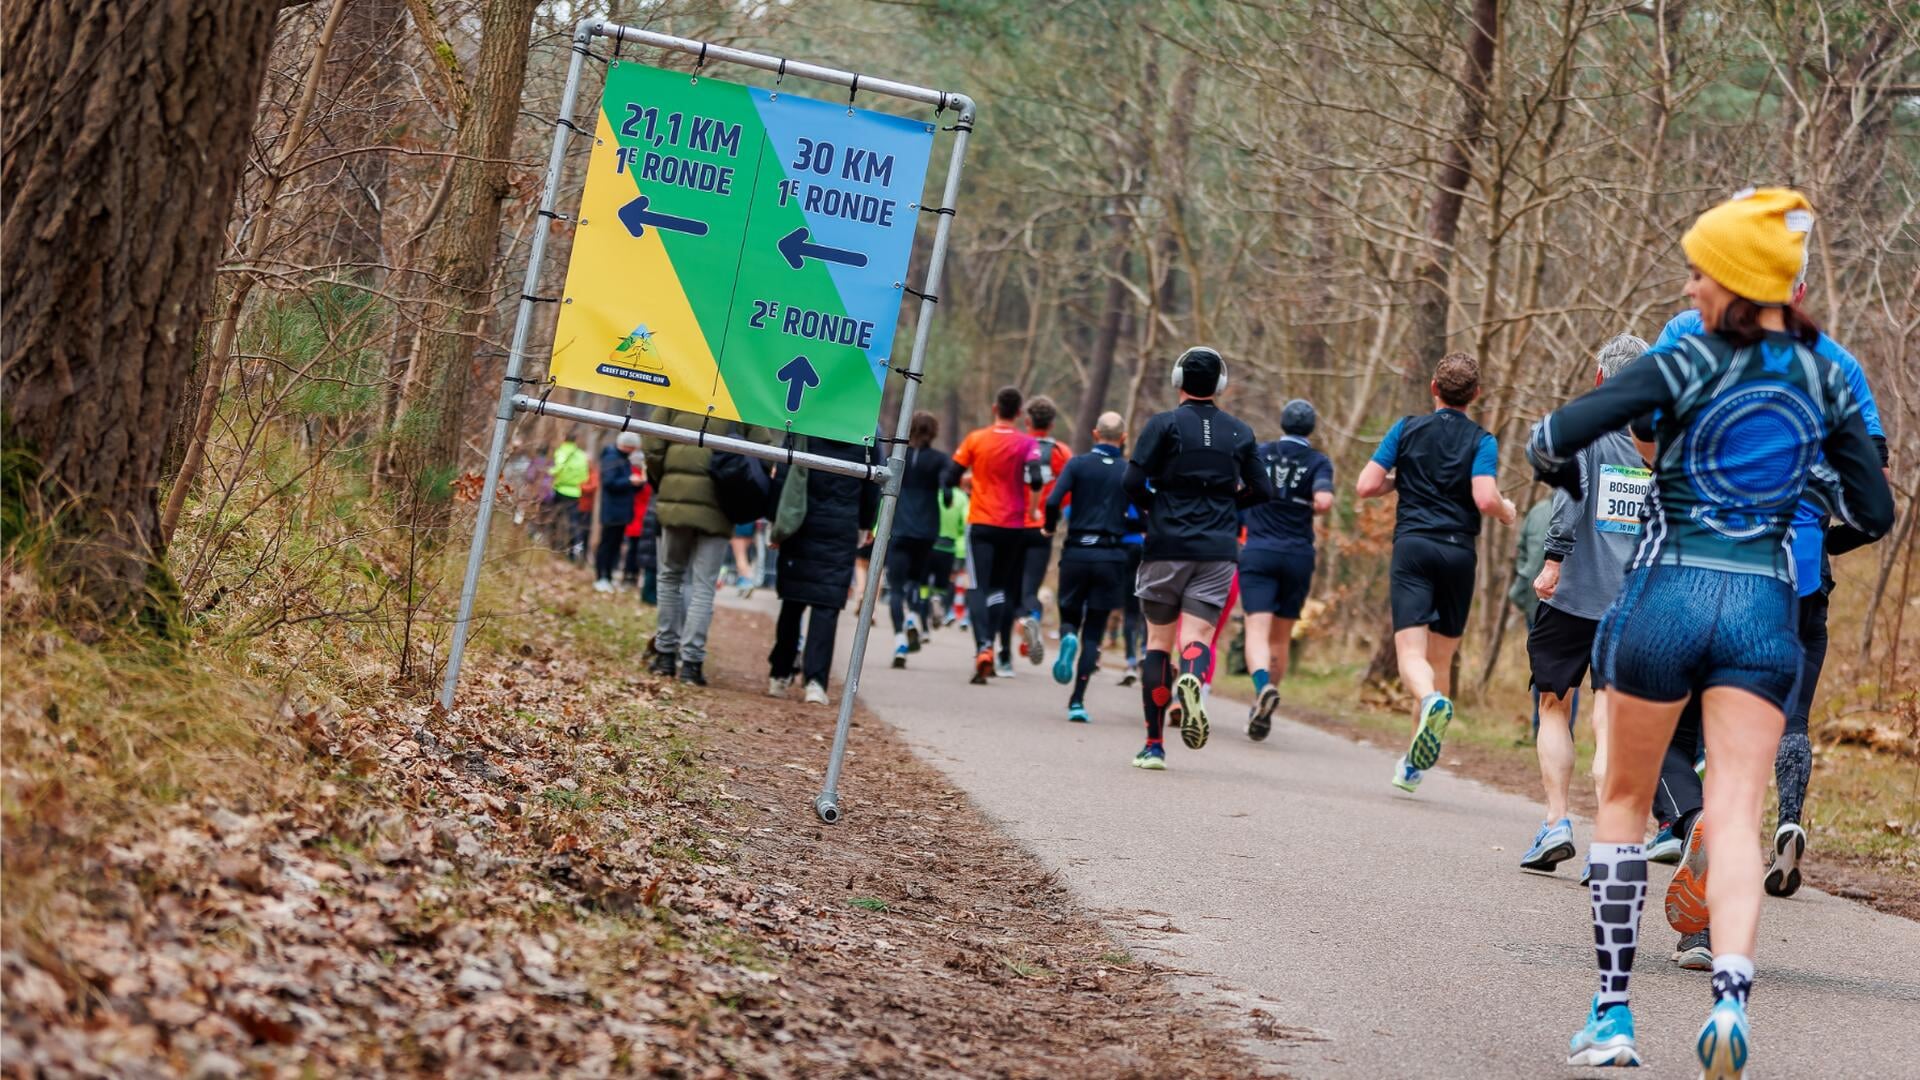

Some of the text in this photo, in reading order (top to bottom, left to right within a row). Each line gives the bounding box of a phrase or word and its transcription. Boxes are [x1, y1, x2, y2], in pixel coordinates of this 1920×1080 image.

[621, 103, 741, 157] 21,1 KM
[642, 152, 734, 195] RONDE
[792, 137, 894, 187] 30 KM
[804, 185, 896, 227] RONDE
[783, 307, 874, 349] RONDE
[1202, 419, 1211, 447] KIPRUN
[1609, 481, 1649, 496] BOSBOO
